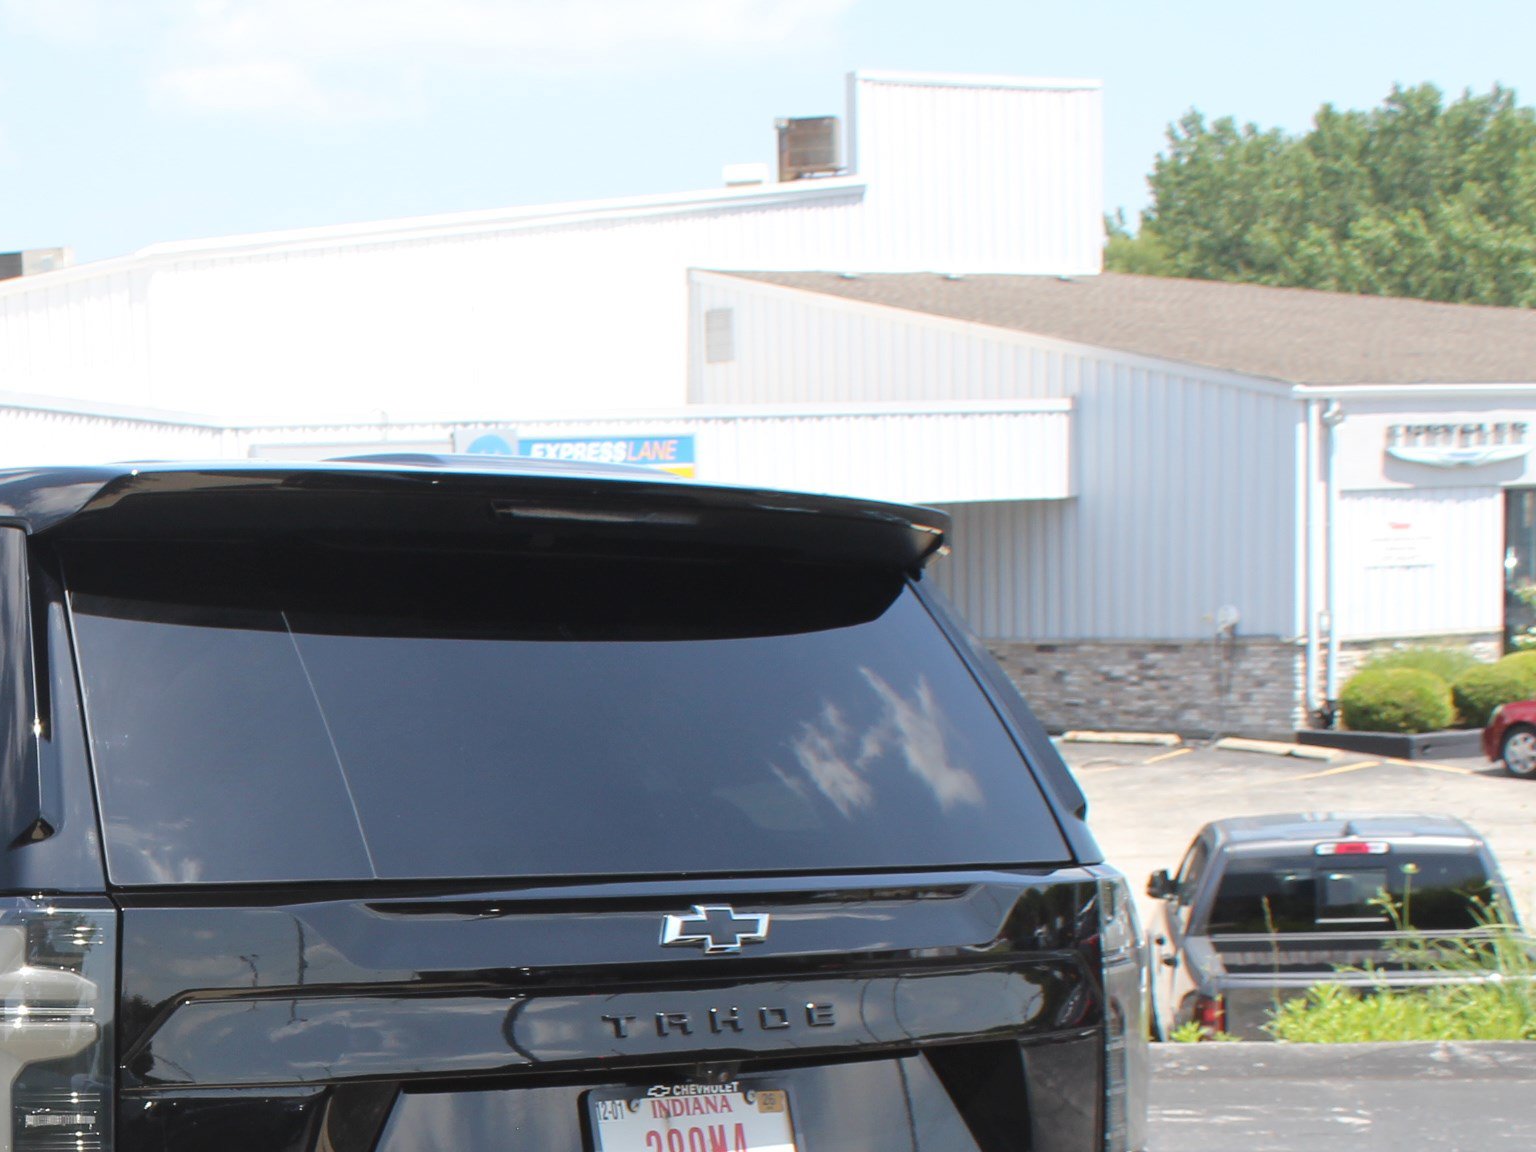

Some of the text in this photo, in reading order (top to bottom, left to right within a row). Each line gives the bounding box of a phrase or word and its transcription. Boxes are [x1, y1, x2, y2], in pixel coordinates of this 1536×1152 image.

[601, 1001, 836, 1039] TAHOE
[672, 1081, 740, 1097] CHEVROLET
[650, 1094, 733, 1119] INDIANA
